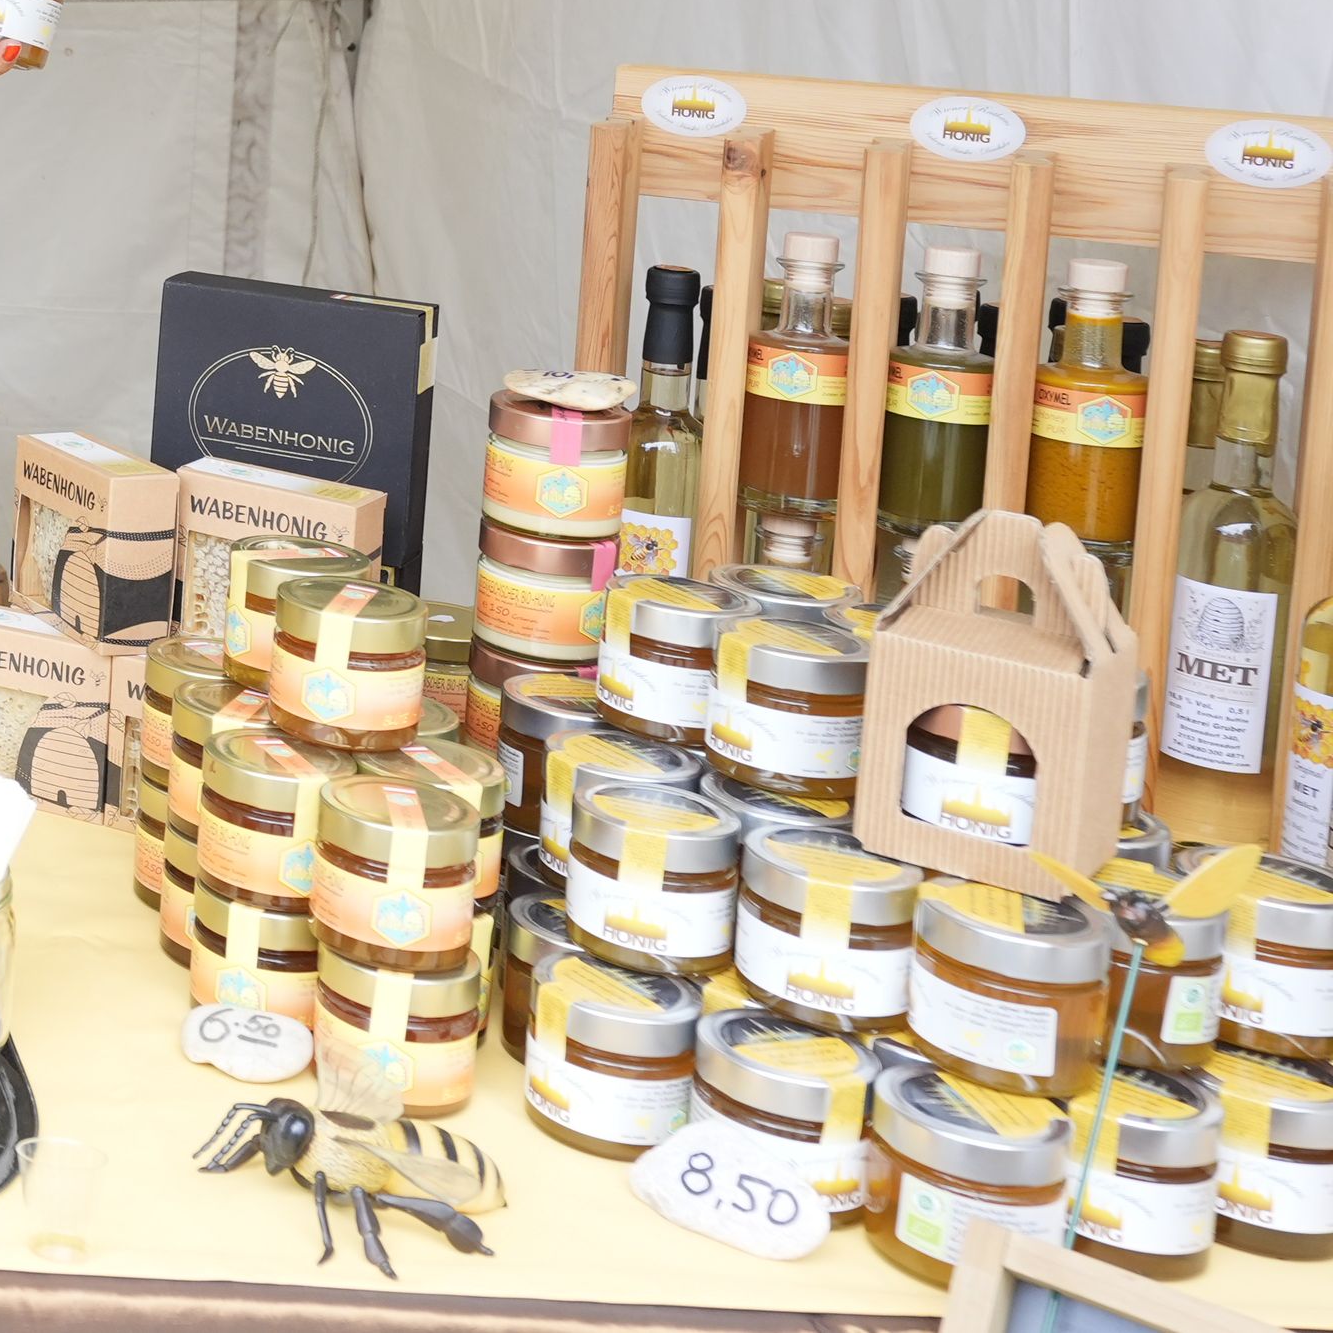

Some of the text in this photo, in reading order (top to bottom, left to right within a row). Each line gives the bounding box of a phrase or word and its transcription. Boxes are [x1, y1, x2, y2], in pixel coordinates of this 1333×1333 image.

[671, 106, 715, 120] HONIG
[942, 128, 990, 143] HONIG
[1241, 153, 1295, 169] HONIG
[203, 415, 356, 456] WABENHONIG
[22, 459, 97, 512] WABENHONIG
[189, 494, 328, 542] WABENHONIG
[1176, 651, 1259, 686] MET
[940, 810, 1013, 839] HONIG
[602, 924, 668, 952] HONIG
[786, 984, 856, 1012] HONIG
[680, 1152, 799, 1225] 8,50
